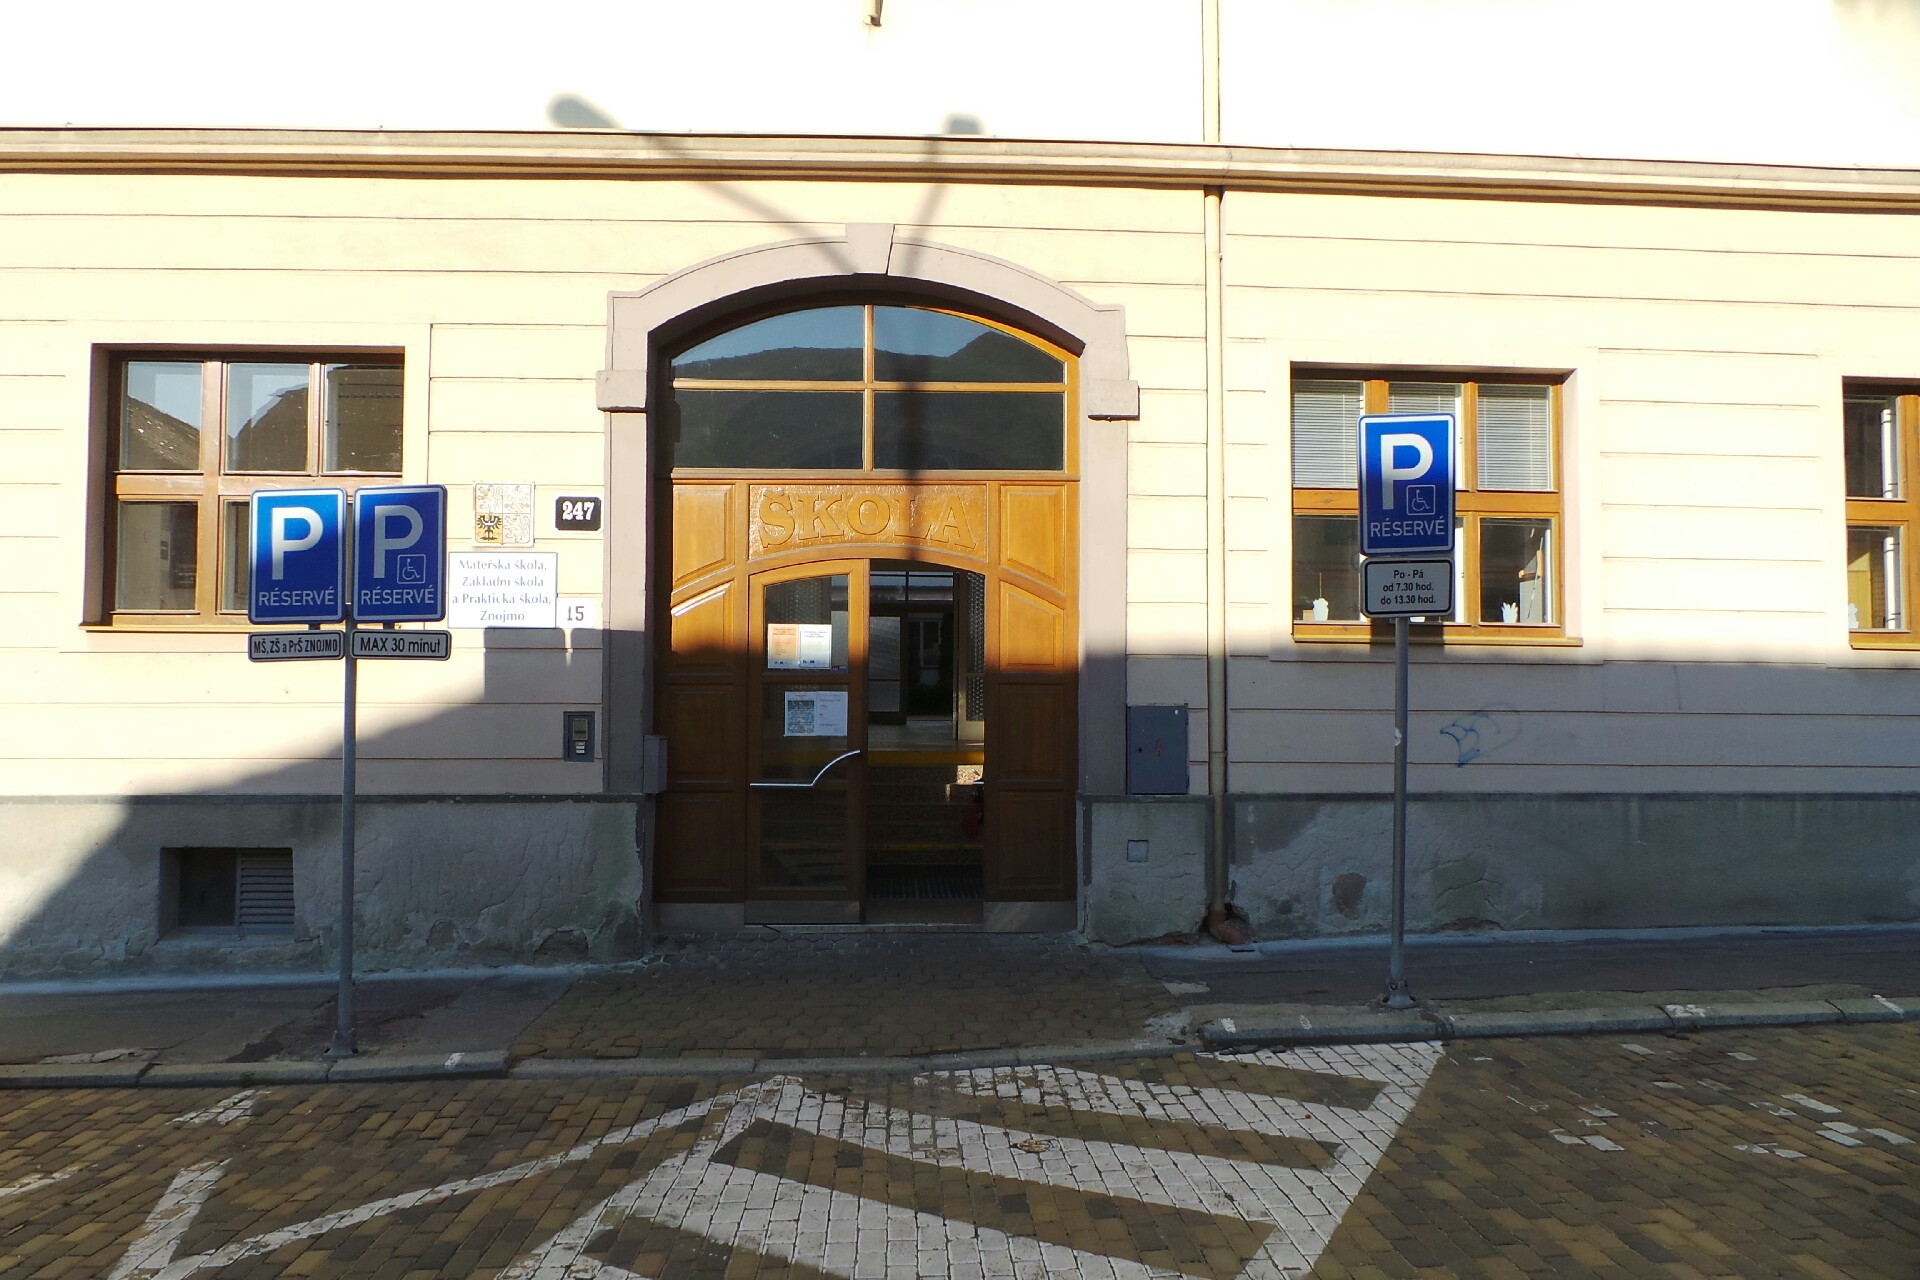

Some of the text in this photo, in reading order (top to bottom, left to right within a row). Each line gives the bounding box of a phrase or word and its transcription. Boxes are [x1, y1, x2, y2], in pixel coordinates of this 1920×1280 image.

[1380, 433, 1434, 510] P
[561, 500, 595, 524] 247
[758, 490, 977, 549] ŠKOLA
[1370, 515, 1446, 537] RÉSERVÉ
[270, 506, 324, 581] P
[373, 504, 424, 579] P
[459, 558, 511, 570] Mateřská
[462, 575, 544, 587] Základní škola
[1393, 569, 1406, 579] Po
[1412, 569, 1424, 579] Pá
[360, 584, 435, 605] RÉSERVÉ
[1382, 582, 1434, 592] od 7.30 hod.
[258, 586, 335, 606] RÉSERVÉ
[452, 592, 552, 605] a Praktická škola,
[1380, 595, 1436, 605] do 13.30 hod.
[480, 610, 525, 623] Znojmo
[566, 605, 585, 622] 15
[282, 643, 287, 653] a
[289, 637, 303, 653] PrŠ
[304, 638, 338, 653] ZNOJMO
[359, 637, 441, 653] MAX 30 minut
